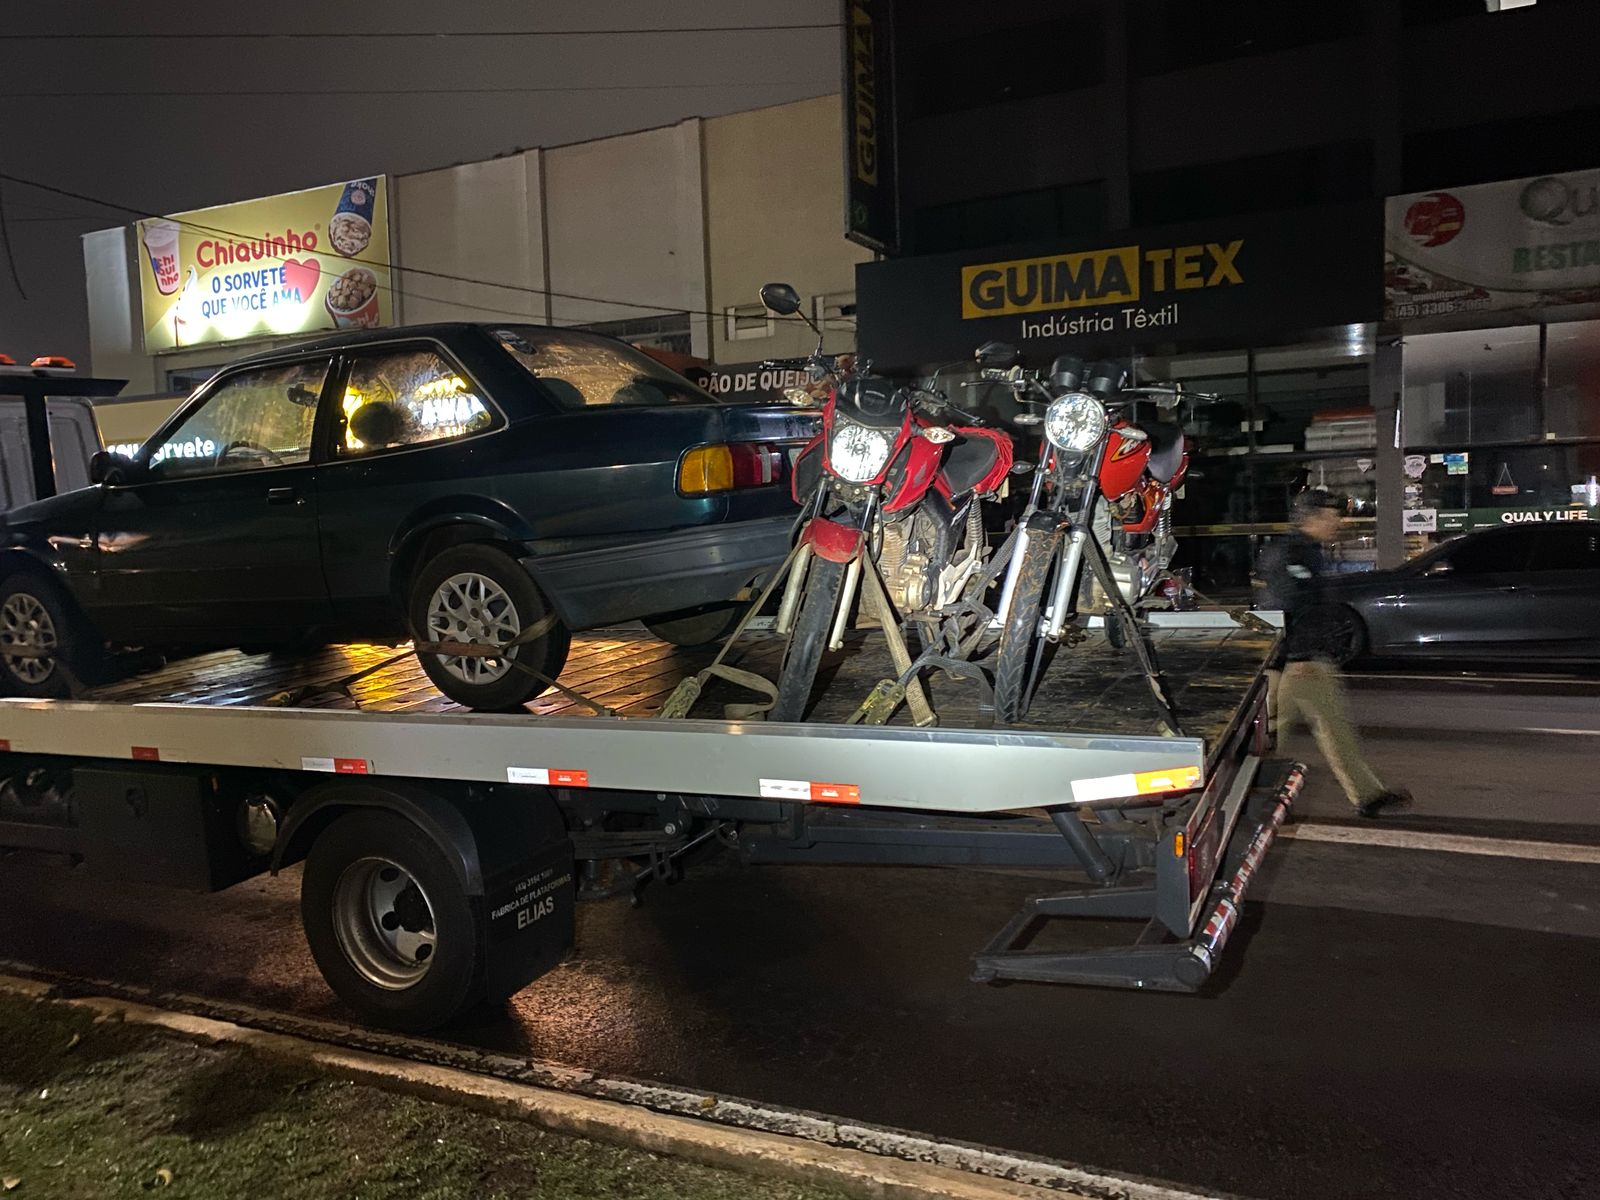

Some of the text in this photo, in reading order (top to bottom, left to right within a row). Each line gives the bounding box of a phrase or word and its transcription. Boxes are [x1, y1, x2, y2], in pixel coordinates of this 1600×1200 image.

[855, 24, 876, 176] GUIMA
[196, 228, 318, 268] Chiquinho
[212, 266, 287, 294] O SORVETE
[969, 240, 1244, 310] GUIMA TEX
[202, 287, 302, 319] QUE VOCÊ AMA
[1021, 303, 1179, 339] Indústria Têxtil
[698, 372, 731, 393] PÃO
[734, 373, 757, 392] DE
[153, 436, 216, 461] orvete
[1501, 509, 1589, 524] QUALY LIFE
[491, 900, 519, 920] FABRICA
[520, 894, 529, 906] DE
[517, 896, 555, 929] ELIAS
